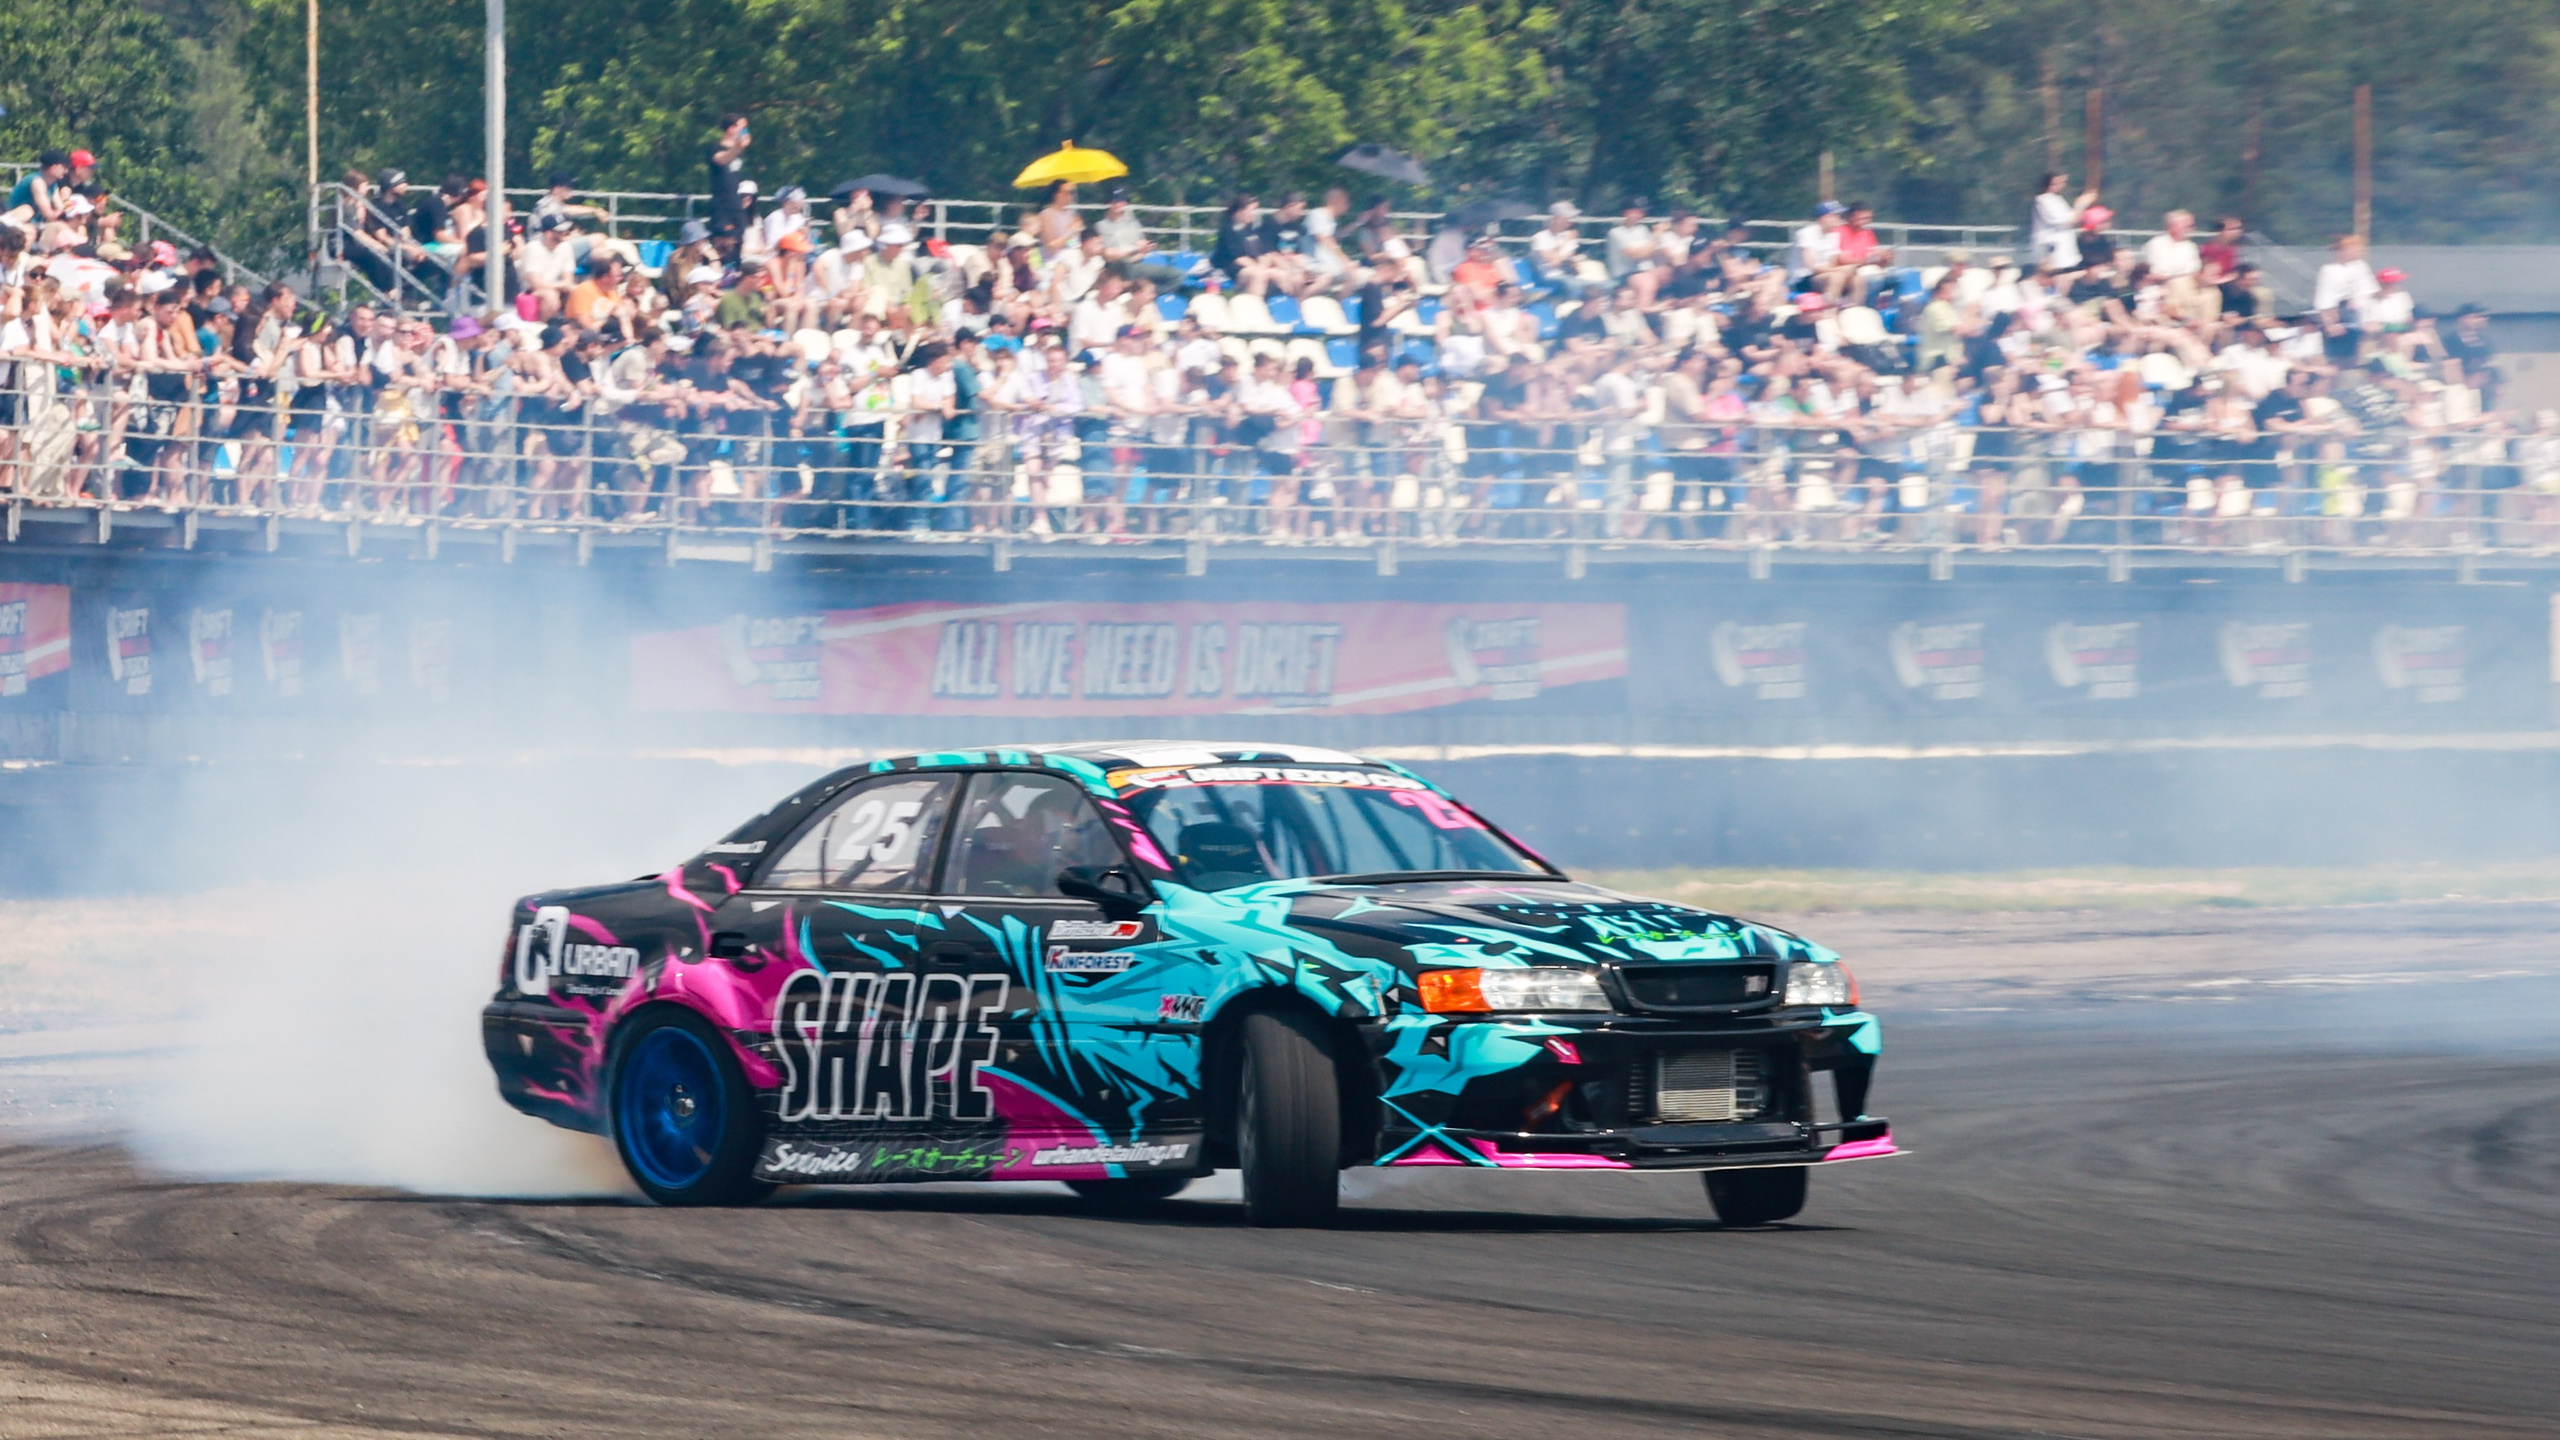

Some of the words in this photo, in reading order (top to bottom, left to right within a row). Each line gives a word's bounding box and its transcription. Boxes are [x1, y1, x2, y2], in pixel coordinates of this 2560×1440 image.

[932, 621, 999, 698] ALL
[1013, 622, 1076, 698] WE
[1084, 622, 1180, 698] NEED
[1187, 622, 1227, 698] IS
[1234, 622, 1343, 698] DRIFT
[1187, 767, 1281, 782] DRIFT
[1281, 769, 1369, 786] EXPO
[835, 800, 923, 863] 25
[564, 944, 640, 978] URBAN
[1046, 948, 1131, 970] KINFOREST
[772, 968, 1010, 1121] SHAPE
[765, 1143, 862, 1175] Service
